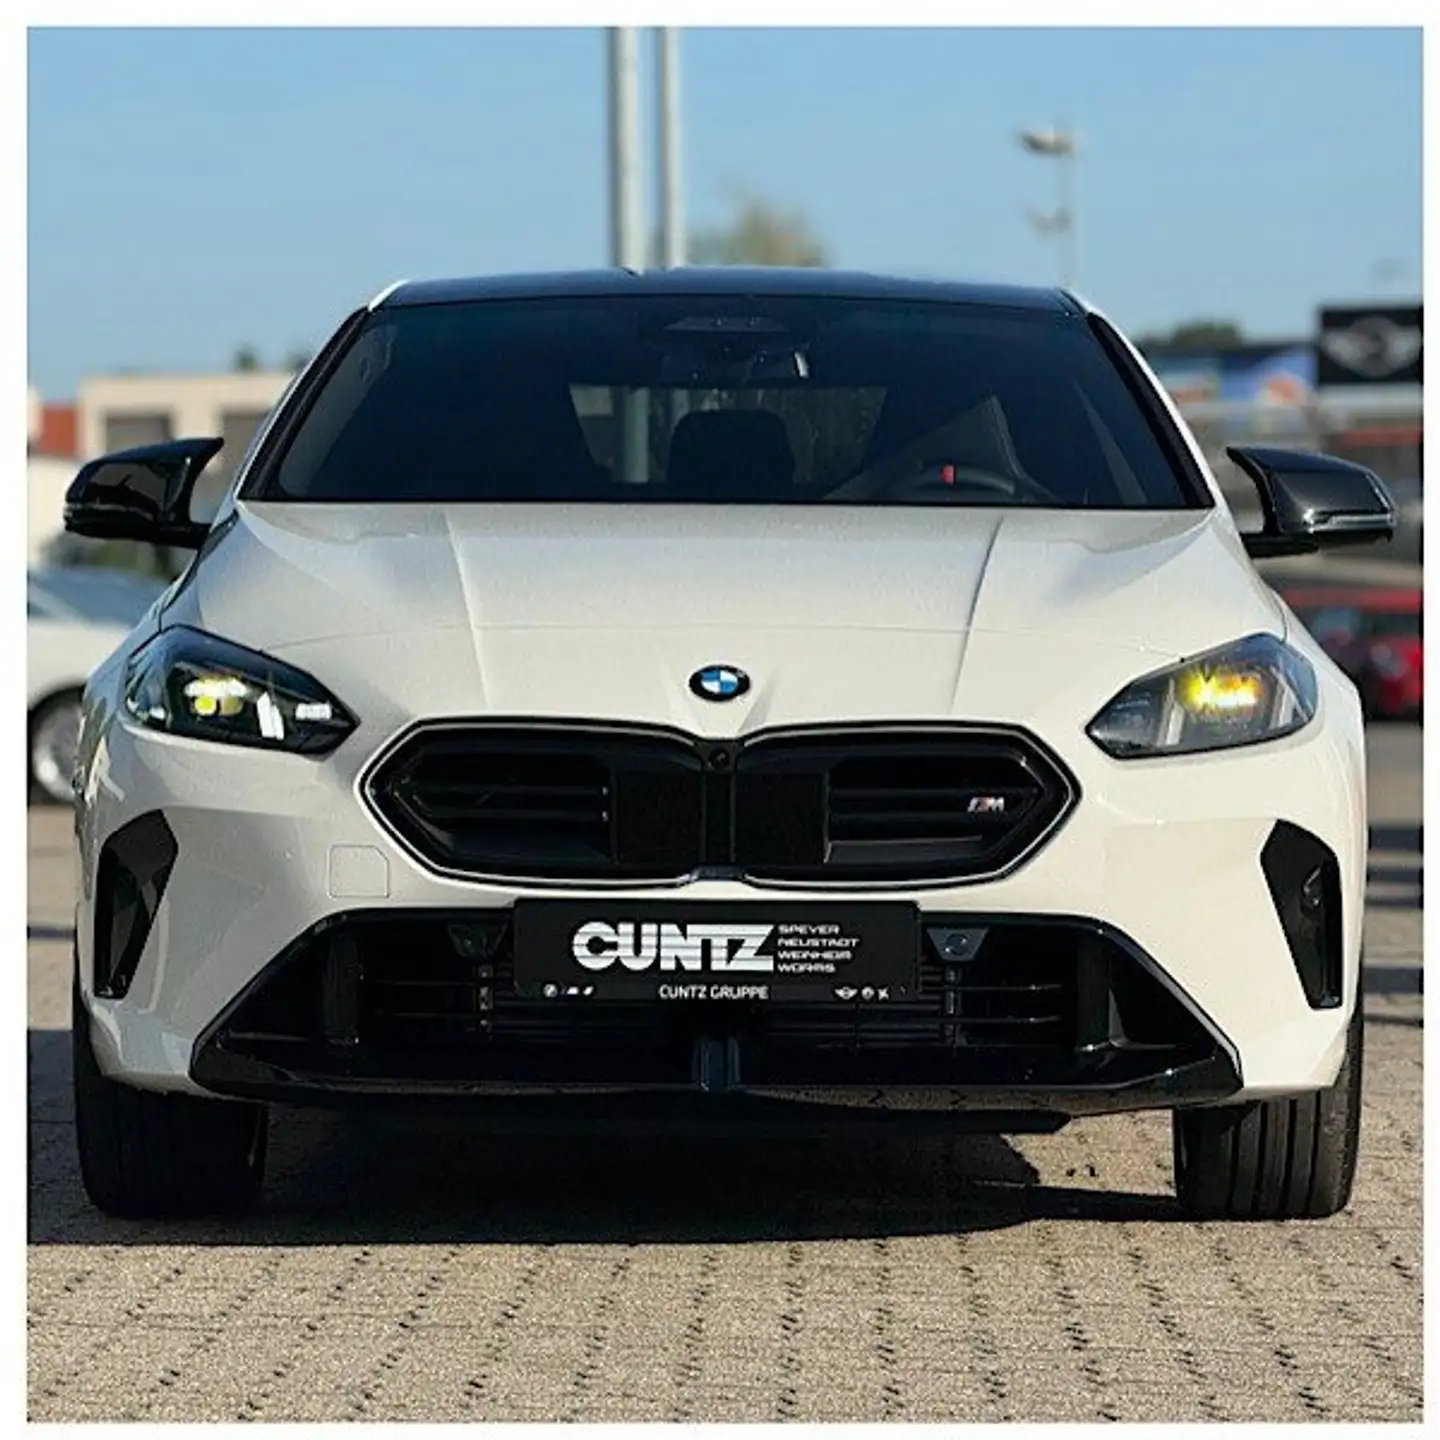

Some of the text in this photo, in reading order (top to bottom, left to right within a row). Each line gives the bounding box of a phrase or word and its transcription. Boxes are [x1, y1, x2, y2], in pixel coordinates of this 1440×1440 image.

[777, 924, 840, 935] SPEYER
[571, 921, 774, 971] CUNTZ
[777, 937, 860, 948] NEUSTADT
[658, 984, 770, 1000] CUNTZ GRUPPE
